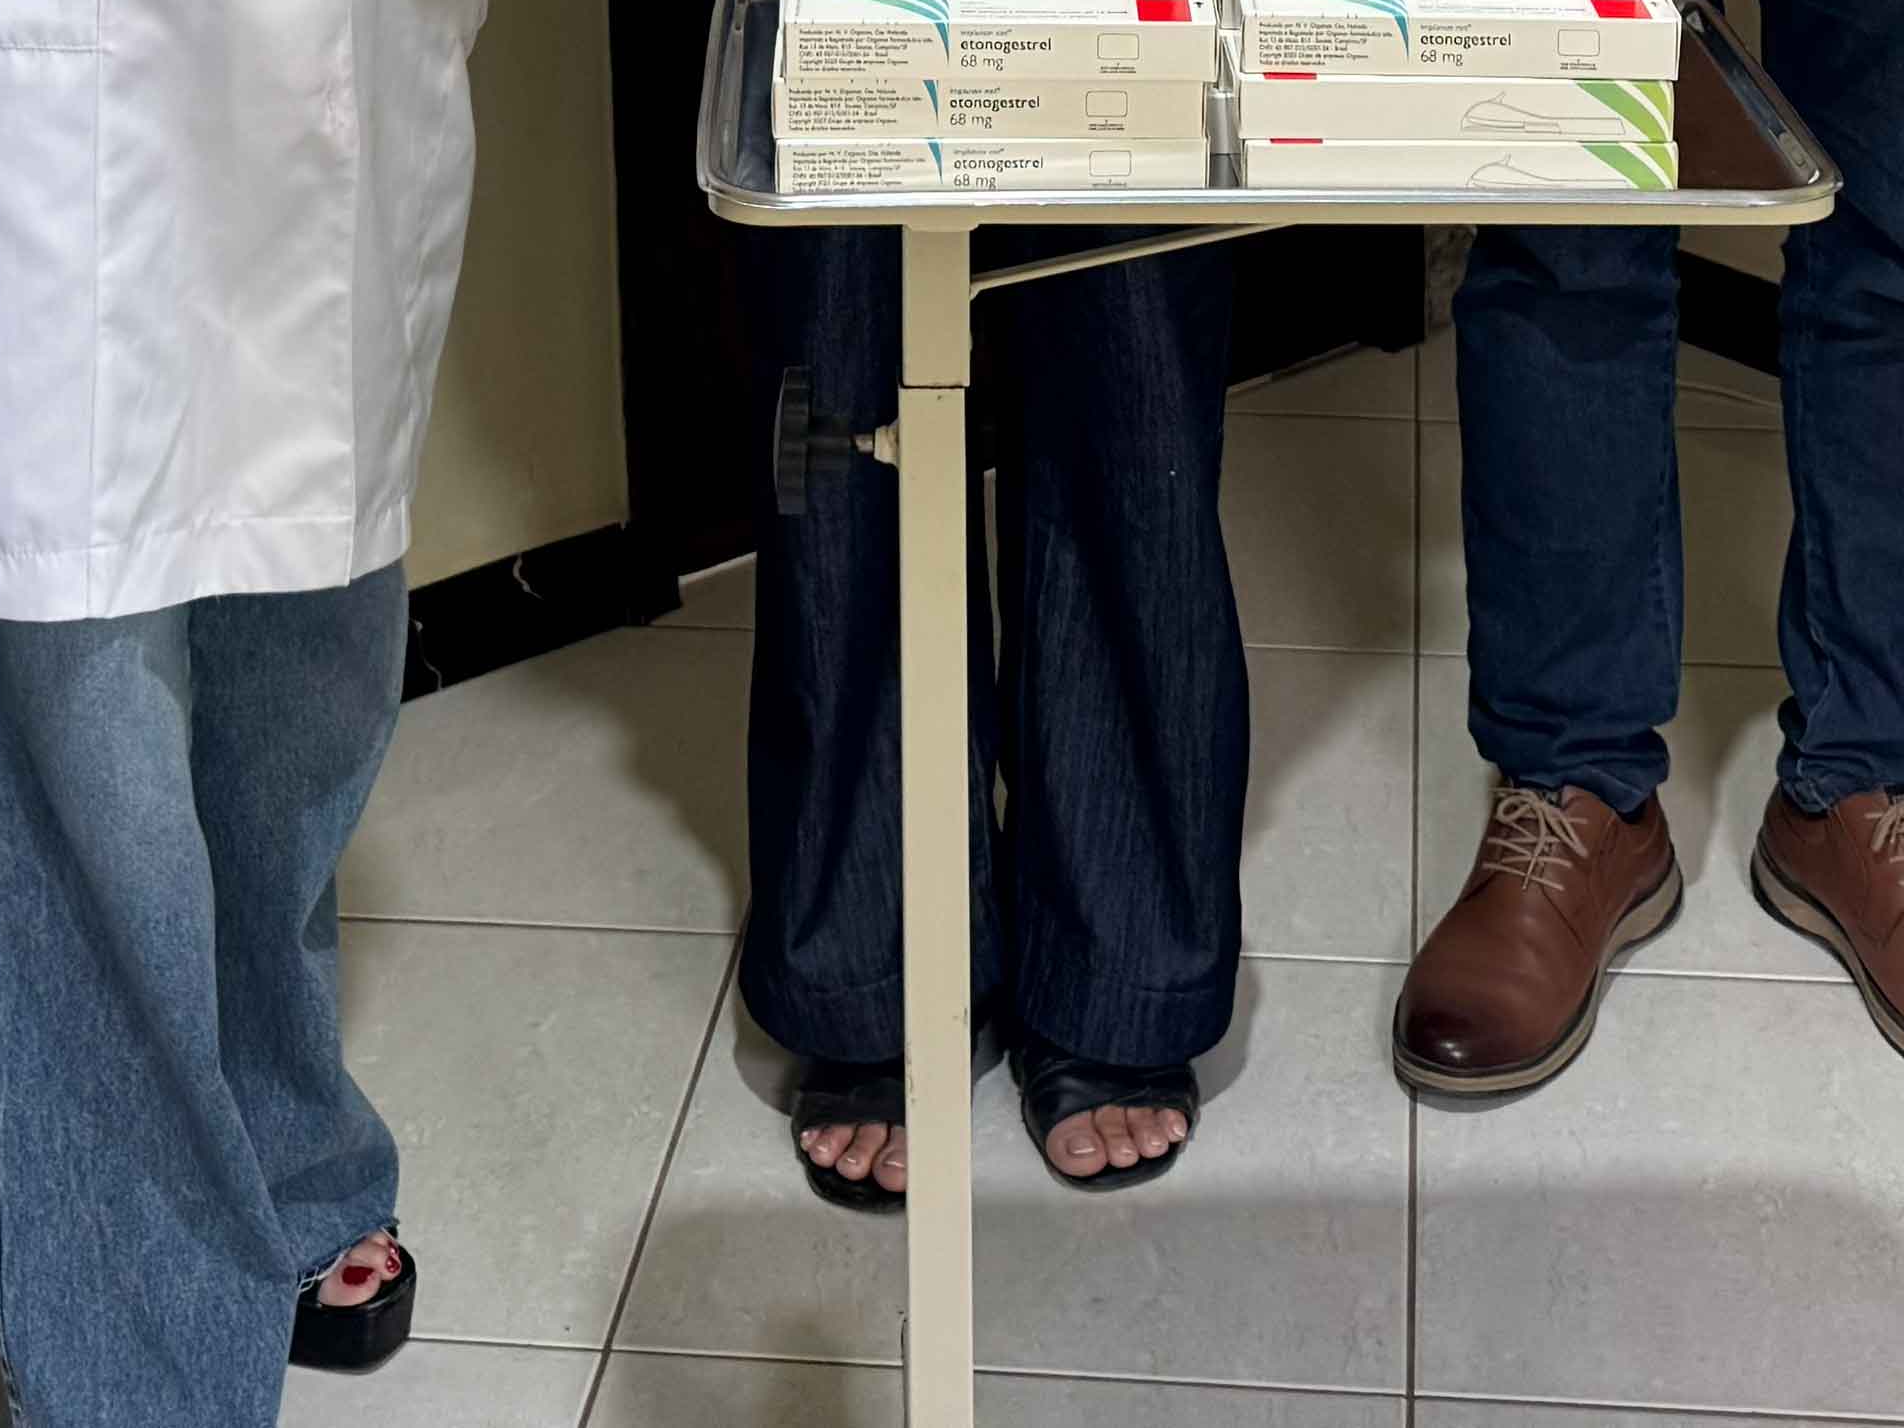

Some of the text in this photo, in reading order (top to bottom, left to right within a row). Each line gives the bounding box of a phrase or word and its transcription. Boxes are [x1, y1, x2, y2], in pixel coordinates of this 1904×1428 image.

[960, 37, 1052, 54] etonogestrel
[1420, 33, 1512, 49] etonogestrel
[960, 55, 1005, 71] 68 mg
[1420, 50, 1464, 66] 68 mg
[950, 95, 1040, 112] etonogestrel
[950, 113, 993, 129] 68 mg
[954, 155, 1044, 172] etonogestrel
[954, 174, 997, 190] 68 mg
